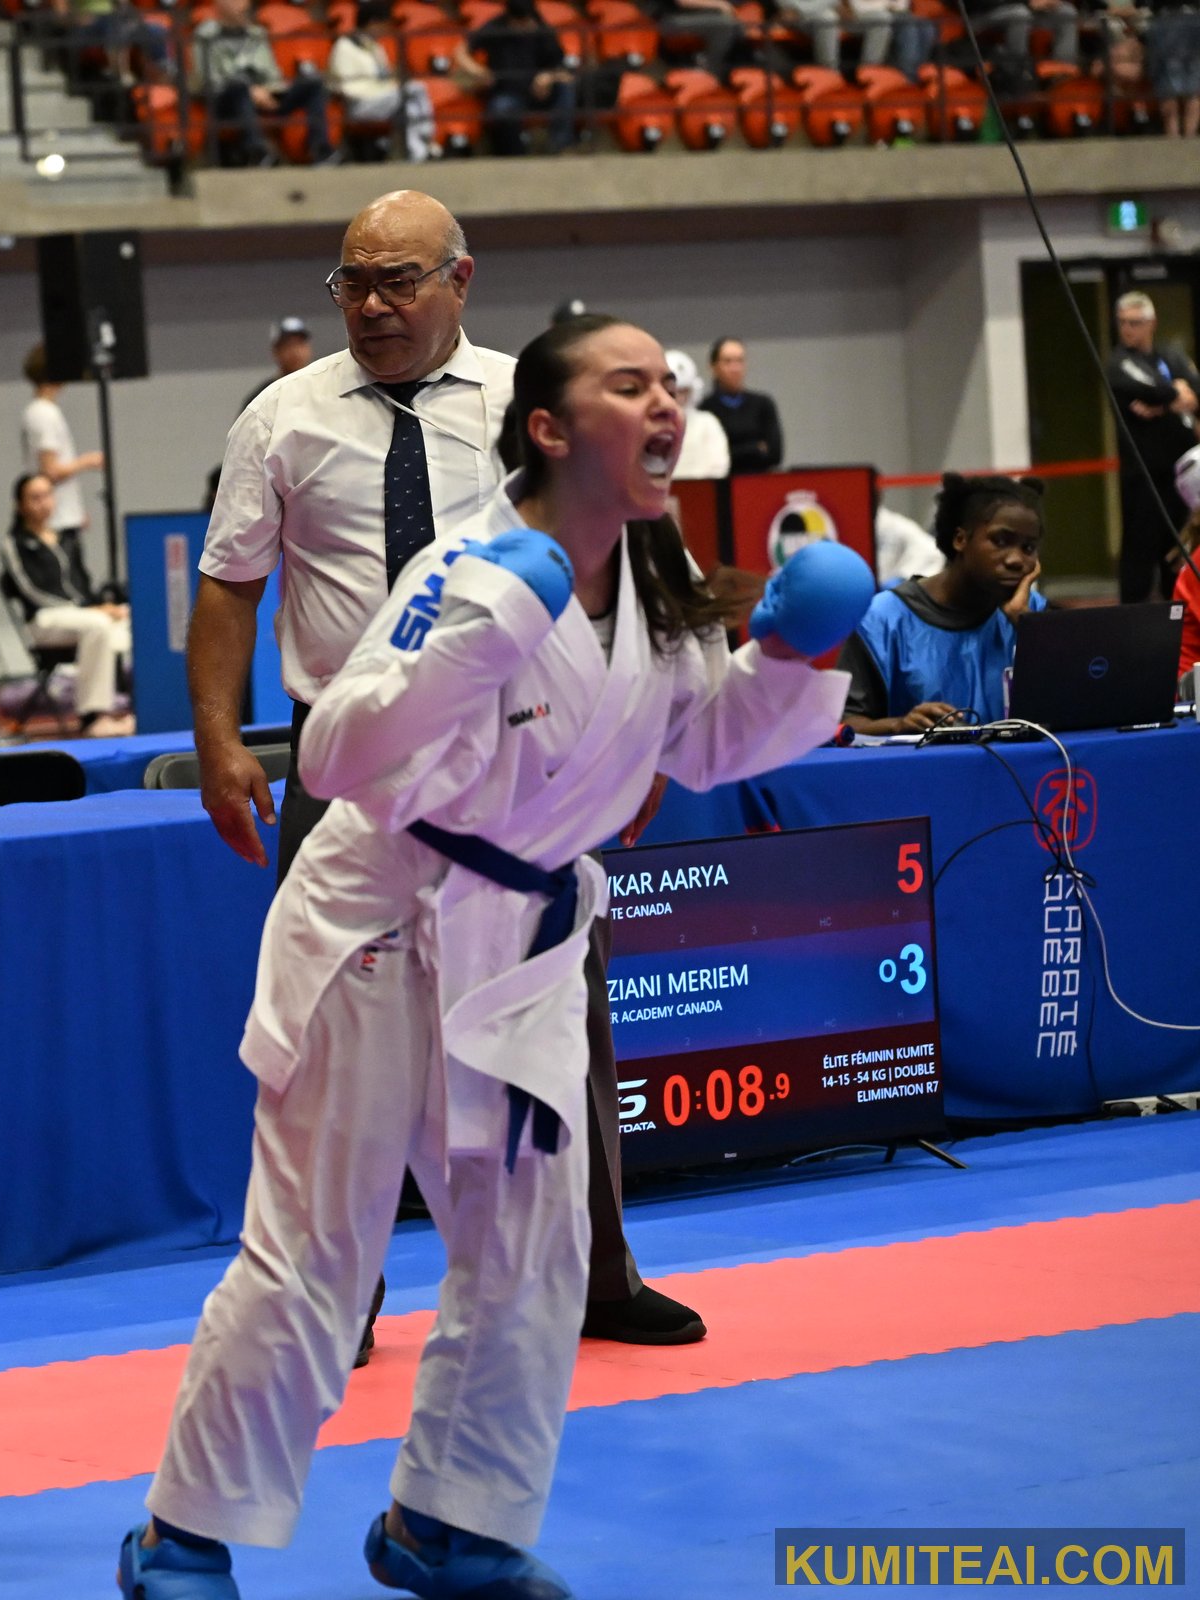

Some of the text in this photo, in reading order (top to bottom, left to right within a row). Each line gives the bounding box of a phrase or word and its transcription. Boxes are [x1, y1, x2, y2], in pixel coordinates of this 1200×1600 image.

[659, 864, 729, 892] AARYA
[897, 843, 924, 893] 5
[625, 902, 673, 918] CANADA
[606, 964, 749, 1002] ZIANI MERIEM
[621, 1005, 674, 1023] ACADEMY
[676, 1000, 723, 1016] CANADA
[823, 1043, 935, 1069] ÉLITE FÉMININ KUMITE
[821, 1073, 850, 1088] 14-15
[852, 1071, 870, 1083] -54
[872, 1069, 887, 1081] KG
[894, 1062, 936, 1079] DOUBLE
[857, 1080, 939, 1103] ELIMINATION R7
